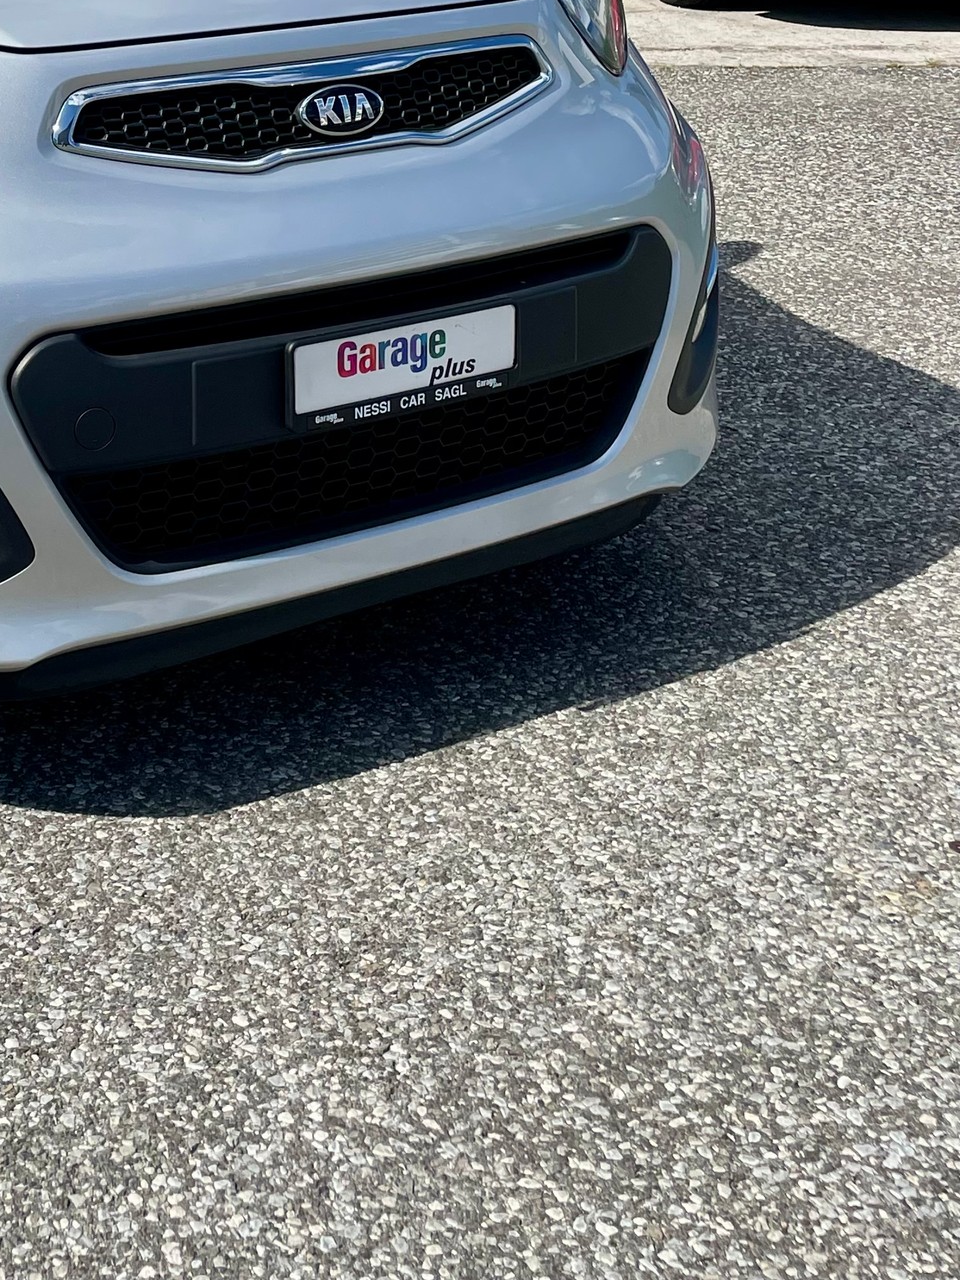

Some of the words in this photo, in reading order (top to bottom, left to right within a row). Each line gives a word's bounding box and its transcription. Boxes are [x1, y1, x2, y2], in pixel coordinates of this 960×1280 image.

[314, 93, 375, 126] KIA
[337, 329, 447, 378] Garage
[429, 357, 476, 386] plus
[476, 377, 497, 388] Garage
[354, 400, 391, 419] NESSI
[400, 393, 426, 409] CAR
[434, 384, 467, 401] SAGL
[315, 413, 338, 424] Garage
